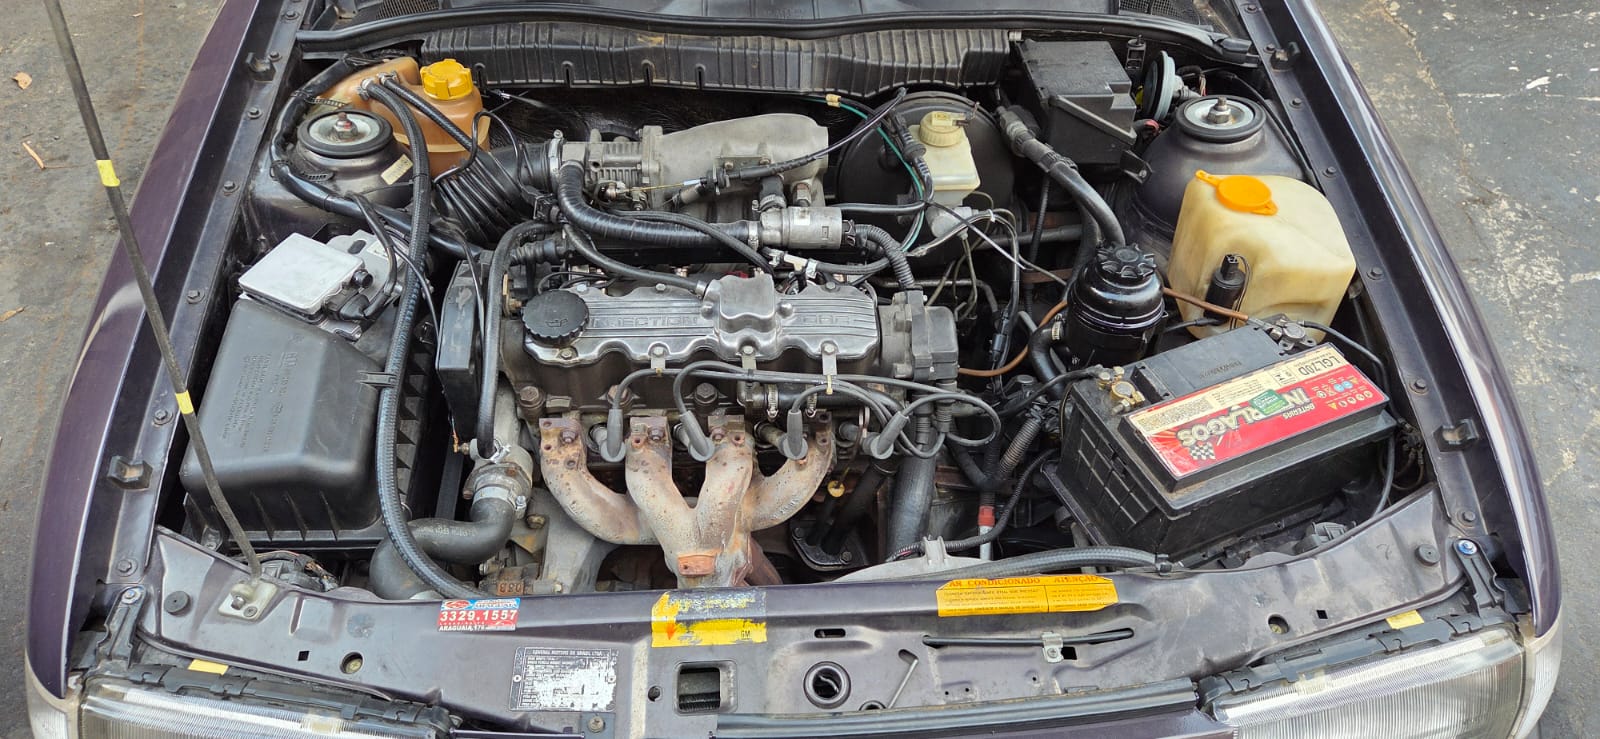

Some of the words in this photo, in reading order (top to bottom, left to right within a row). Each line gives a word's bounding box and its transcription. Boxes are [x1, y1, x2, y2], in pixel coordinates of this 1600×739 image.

[1298, 354, 1341, 376] LGL70D
[1175, 387, 1312, 447] INRLAGOS
[1283, 402, 1315, 420] BATERIAS
[968, 577, 1041, 587] CONDICIONADO
[1054, 575, 1099, 584] ATENÇÃO
[440, 609, 518, 621] 3329.1557
[740, 630, 751, 638] GM
